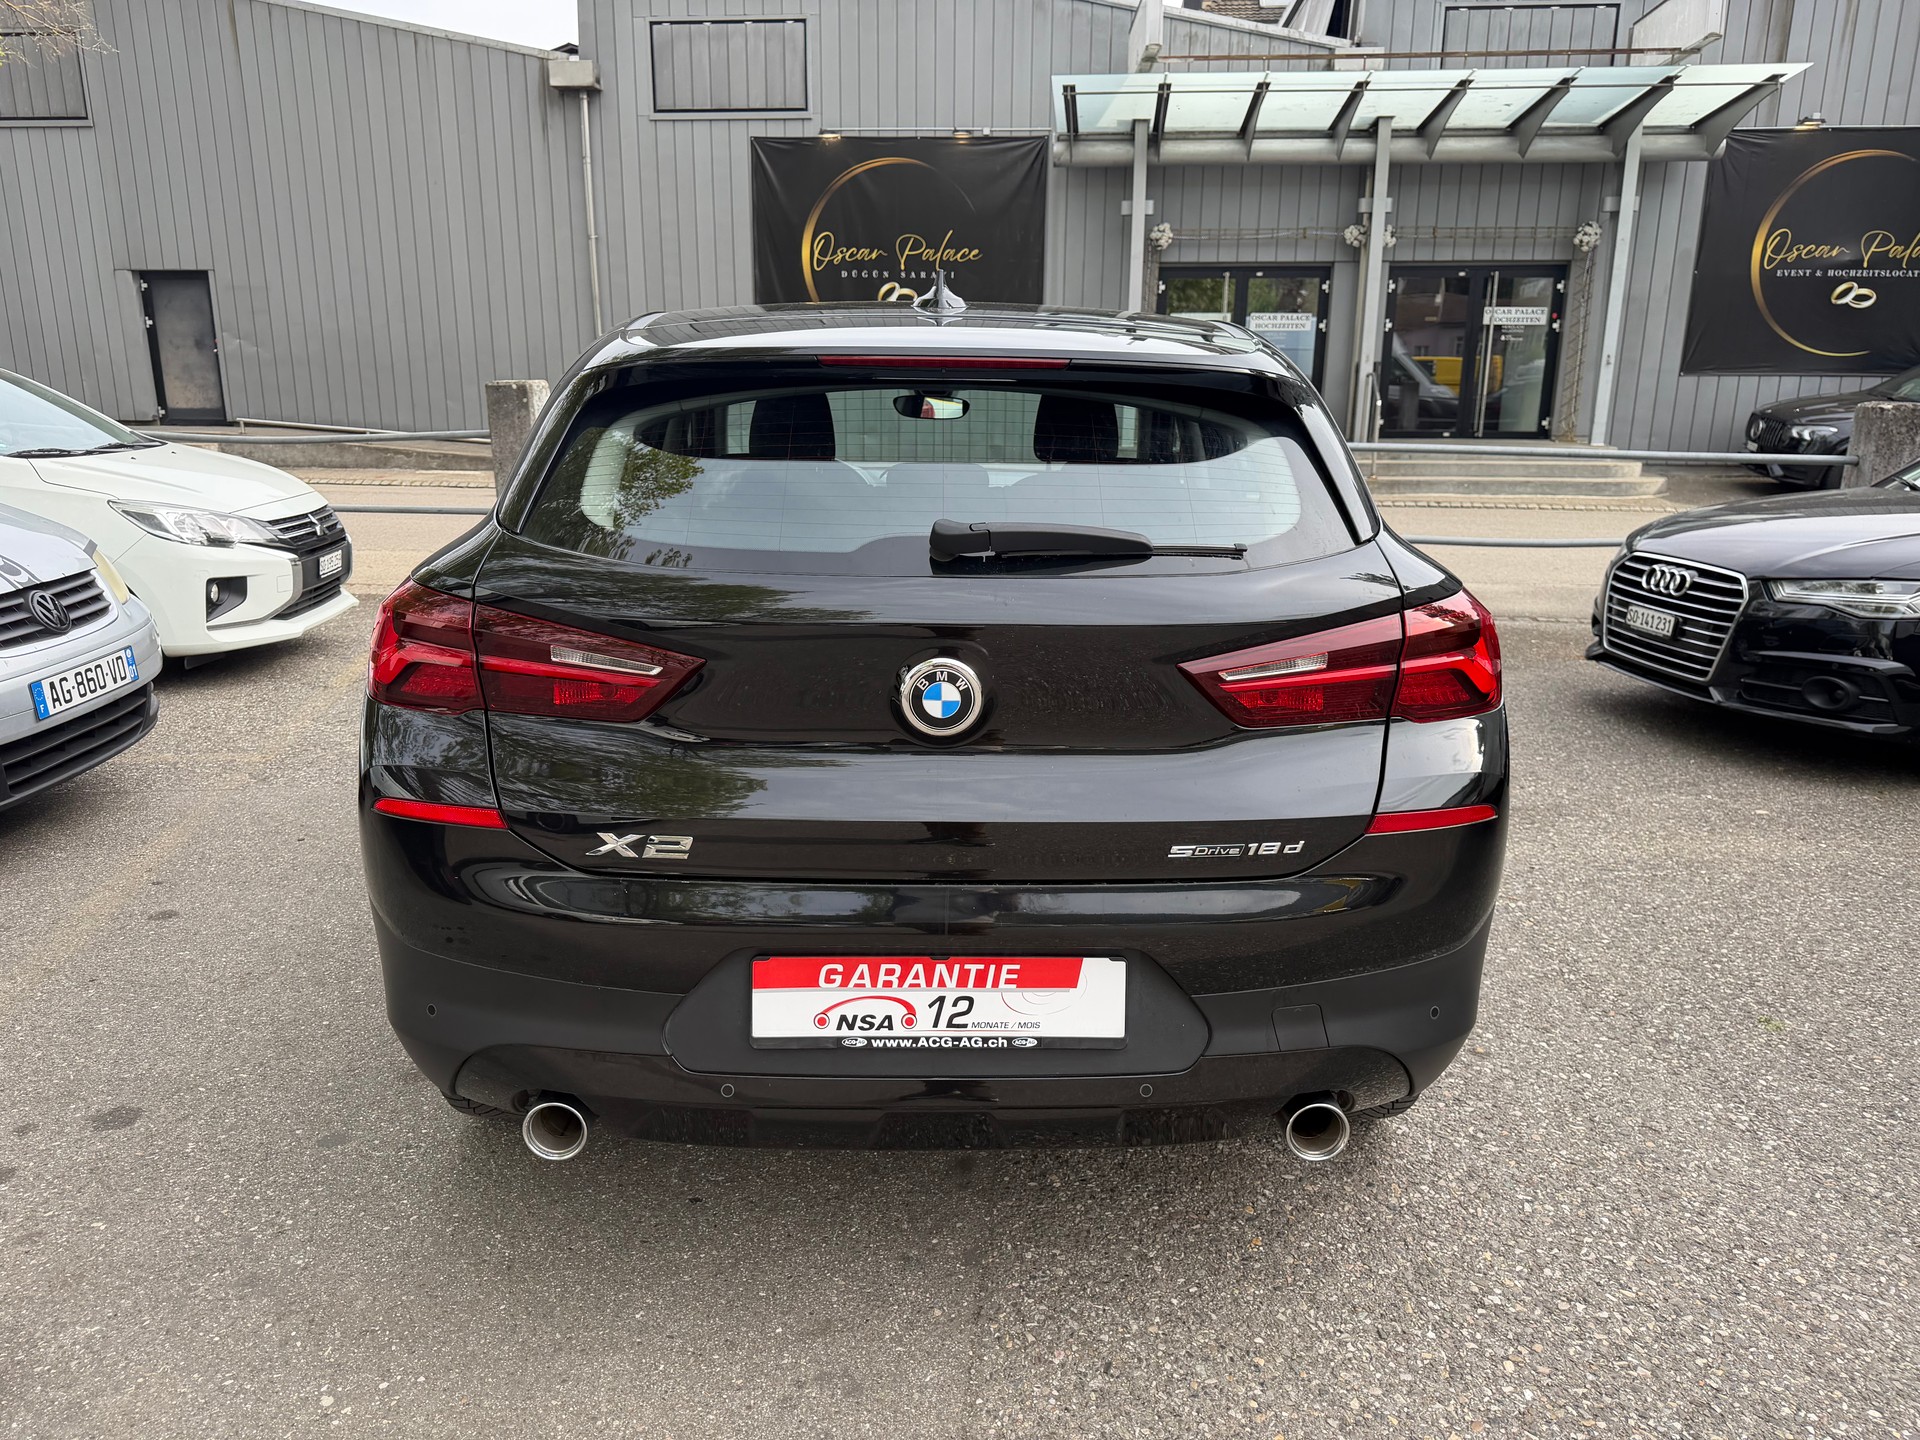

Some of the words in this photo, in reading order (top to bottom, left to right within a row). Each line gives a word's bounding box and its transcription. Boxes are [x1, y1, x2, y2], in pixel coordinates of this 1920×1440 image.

[813, 231, 888, 271] Oscar
[895, 229, 983, 271] Palace
[1763, 228, 1850, 270] Oscar
[1776, 269, 1812, 277] EVENT
[1815, 269, 1823, 277] &
[1484, 308, 1512, 316] OCAR
[1514, 308, 1546, 316] PALACE
[916, 671, 968, 691] BMW
[40, 704, 45, 714] F
[585, 832, 694, 860] X2
[818, 963, 1020, 989] GARANTIE
[927, 995, 975, 1029] 12
[971, 1021, 1010, 1029] MONATE
[1017, 1021, 1041, 1029] MOIS
[836, 1014, 894, 1031] NSA
[871, 1036, 1008, 1048] www.ACG-AG.ch
